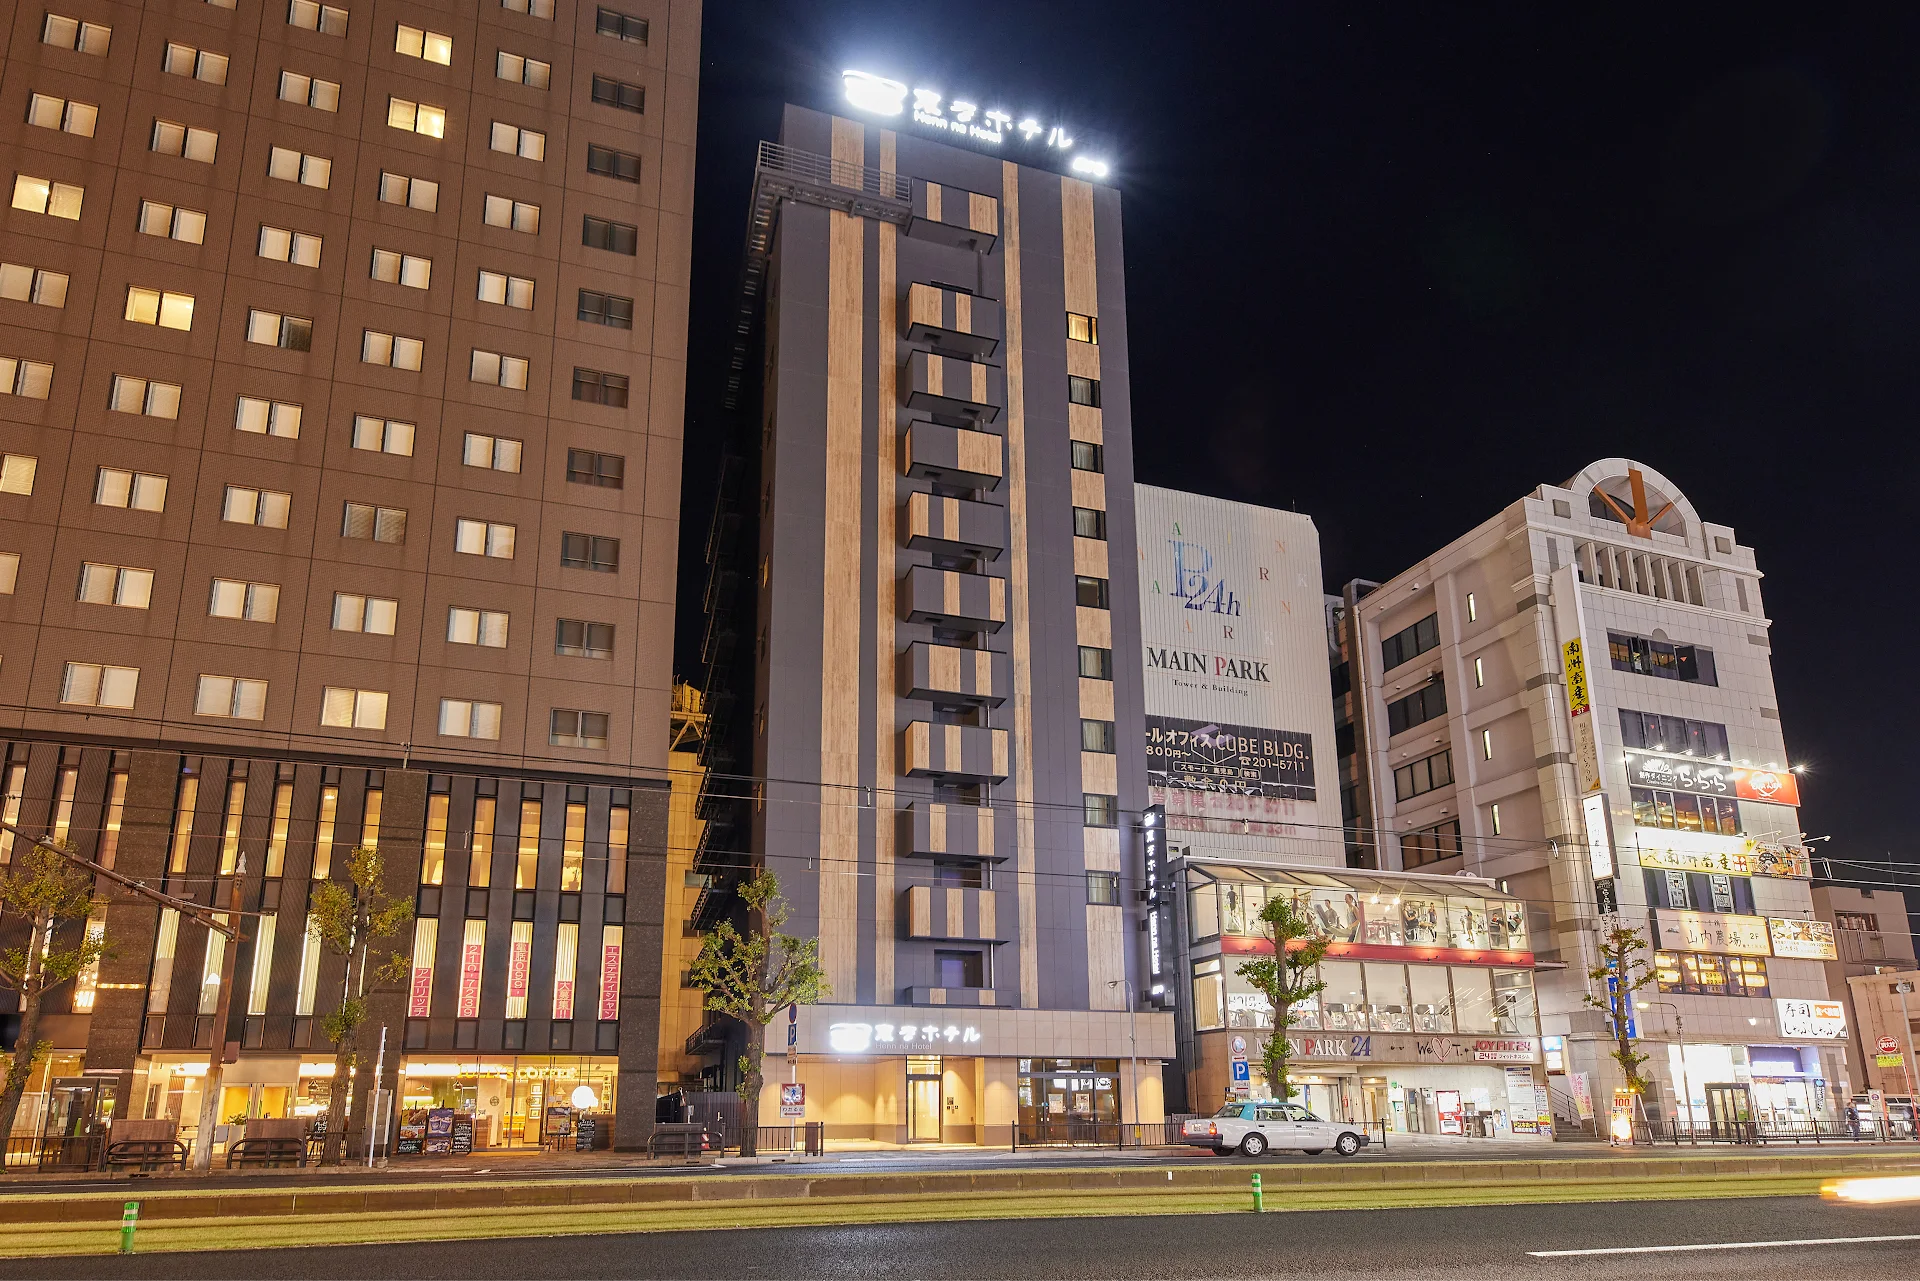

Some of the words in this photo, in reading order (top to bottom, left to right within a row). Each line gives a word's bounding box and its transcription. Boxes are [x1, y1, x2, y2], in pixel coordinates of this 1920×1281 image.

[1146, 647, 1207, 674] MAIN
[1214, 656, 1270, 682] PARK
[1173, 679, 1198, 689] Tower
[1212, 685, 1248, 697] Building
[1215, 731, 1258, 755] CUBE
[1263, 740, 1309, 760] BLDG.
[1181, 764, 1208, 773] スモール
[1253, 758, 1304, 772] 201-5711
[1686, 929, 1742, 947] 山内農場
[604, 946, 619, 1019] エステティシャン
[412, 969, 430, 1016] アイリッチ
[1785, 1002, 1811, 1018] 寿司
[875, 1042, 897, 1050] Henn
[911, 1042, 932, 1050] Hotel
[1255, 1037, 1300, 1056] MN
[1304, 1039, 1348, 1056] PARK
[1350, 1035, 1371, 1057] 24
[1417, 1042, 1432, 1055] We
[1236, 1064, 1246, 1079] P
